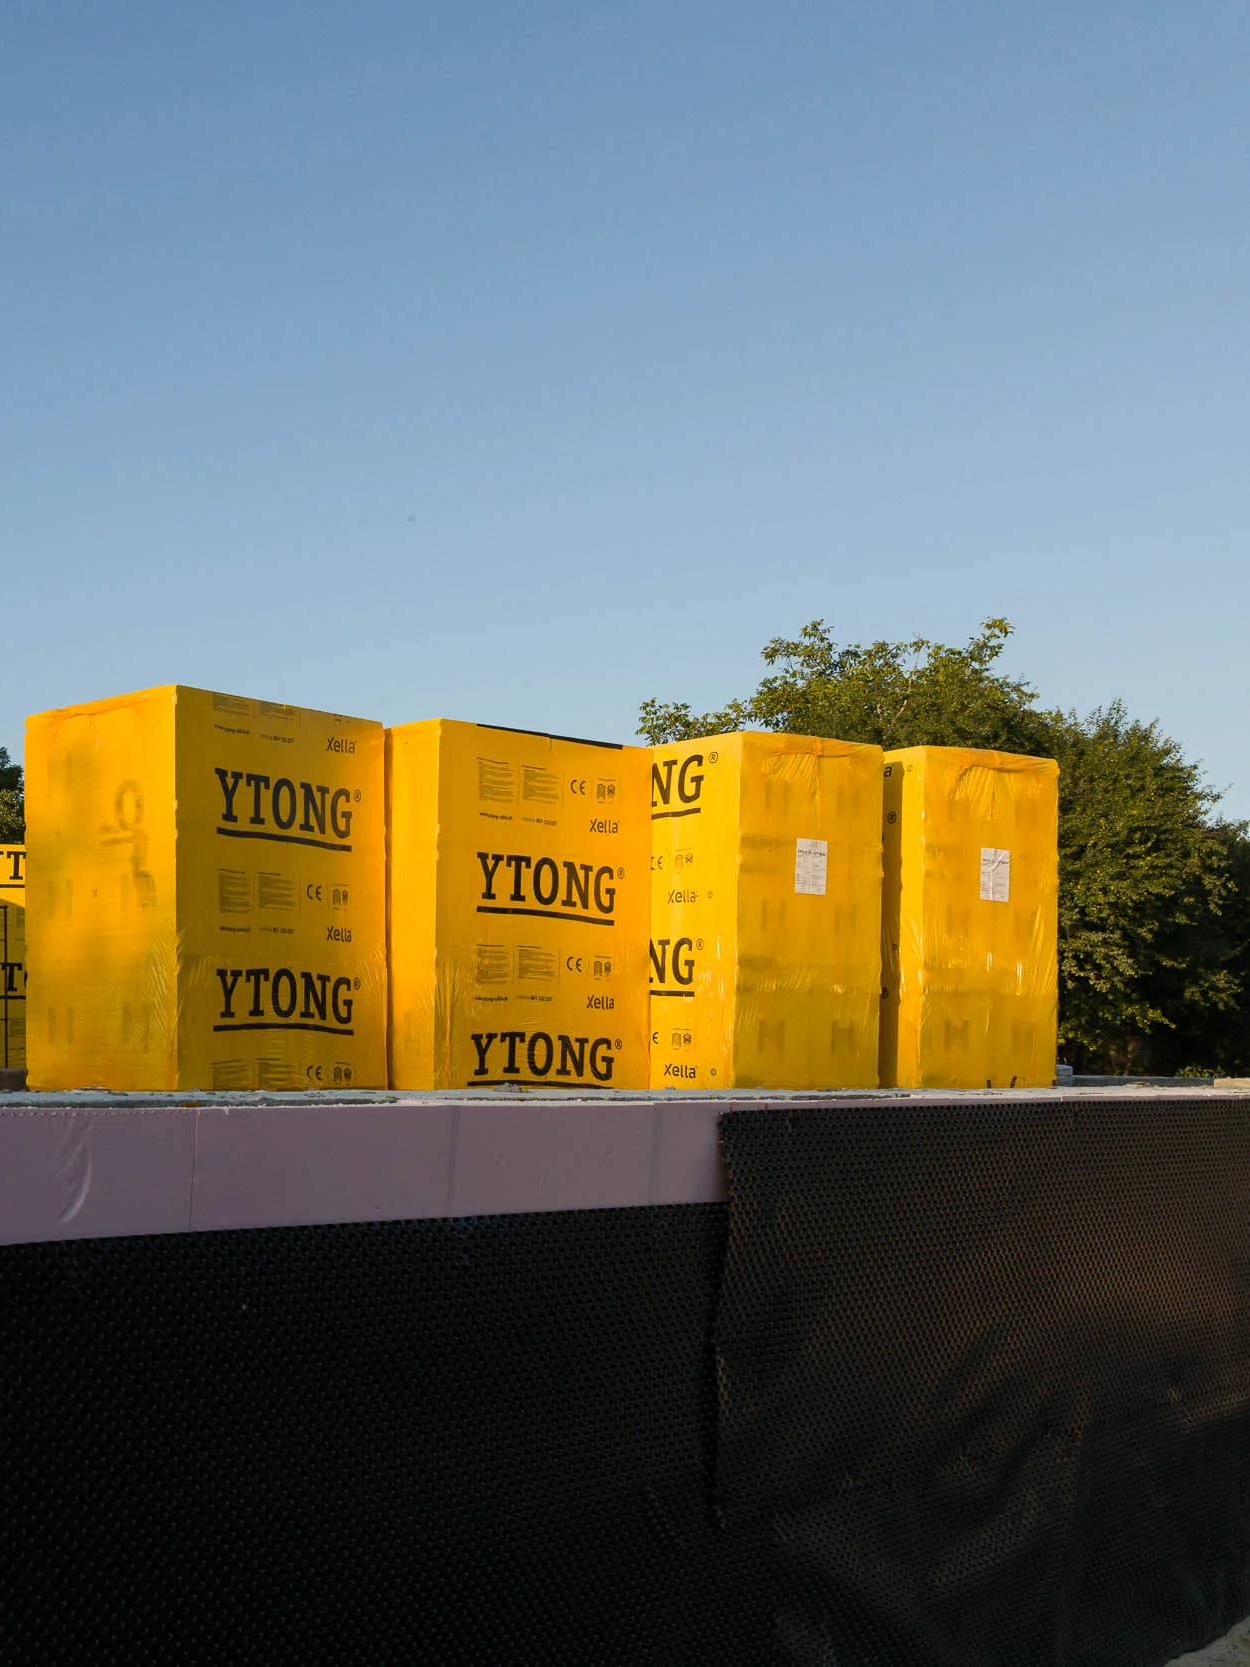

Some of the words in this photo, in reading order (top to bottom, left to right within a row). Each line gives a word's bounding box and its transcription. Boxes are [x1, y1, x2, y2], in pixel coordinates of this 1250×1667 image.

[326, 736, 355, 754] Xella
[589, 818, 618, 835] Xella
[667, 889, 696, 904] Xella
[326, 926, 352, 943] Xella
[586, 995, 615, 1010] Xella
[663, 1063, 697, 1079] Xella
